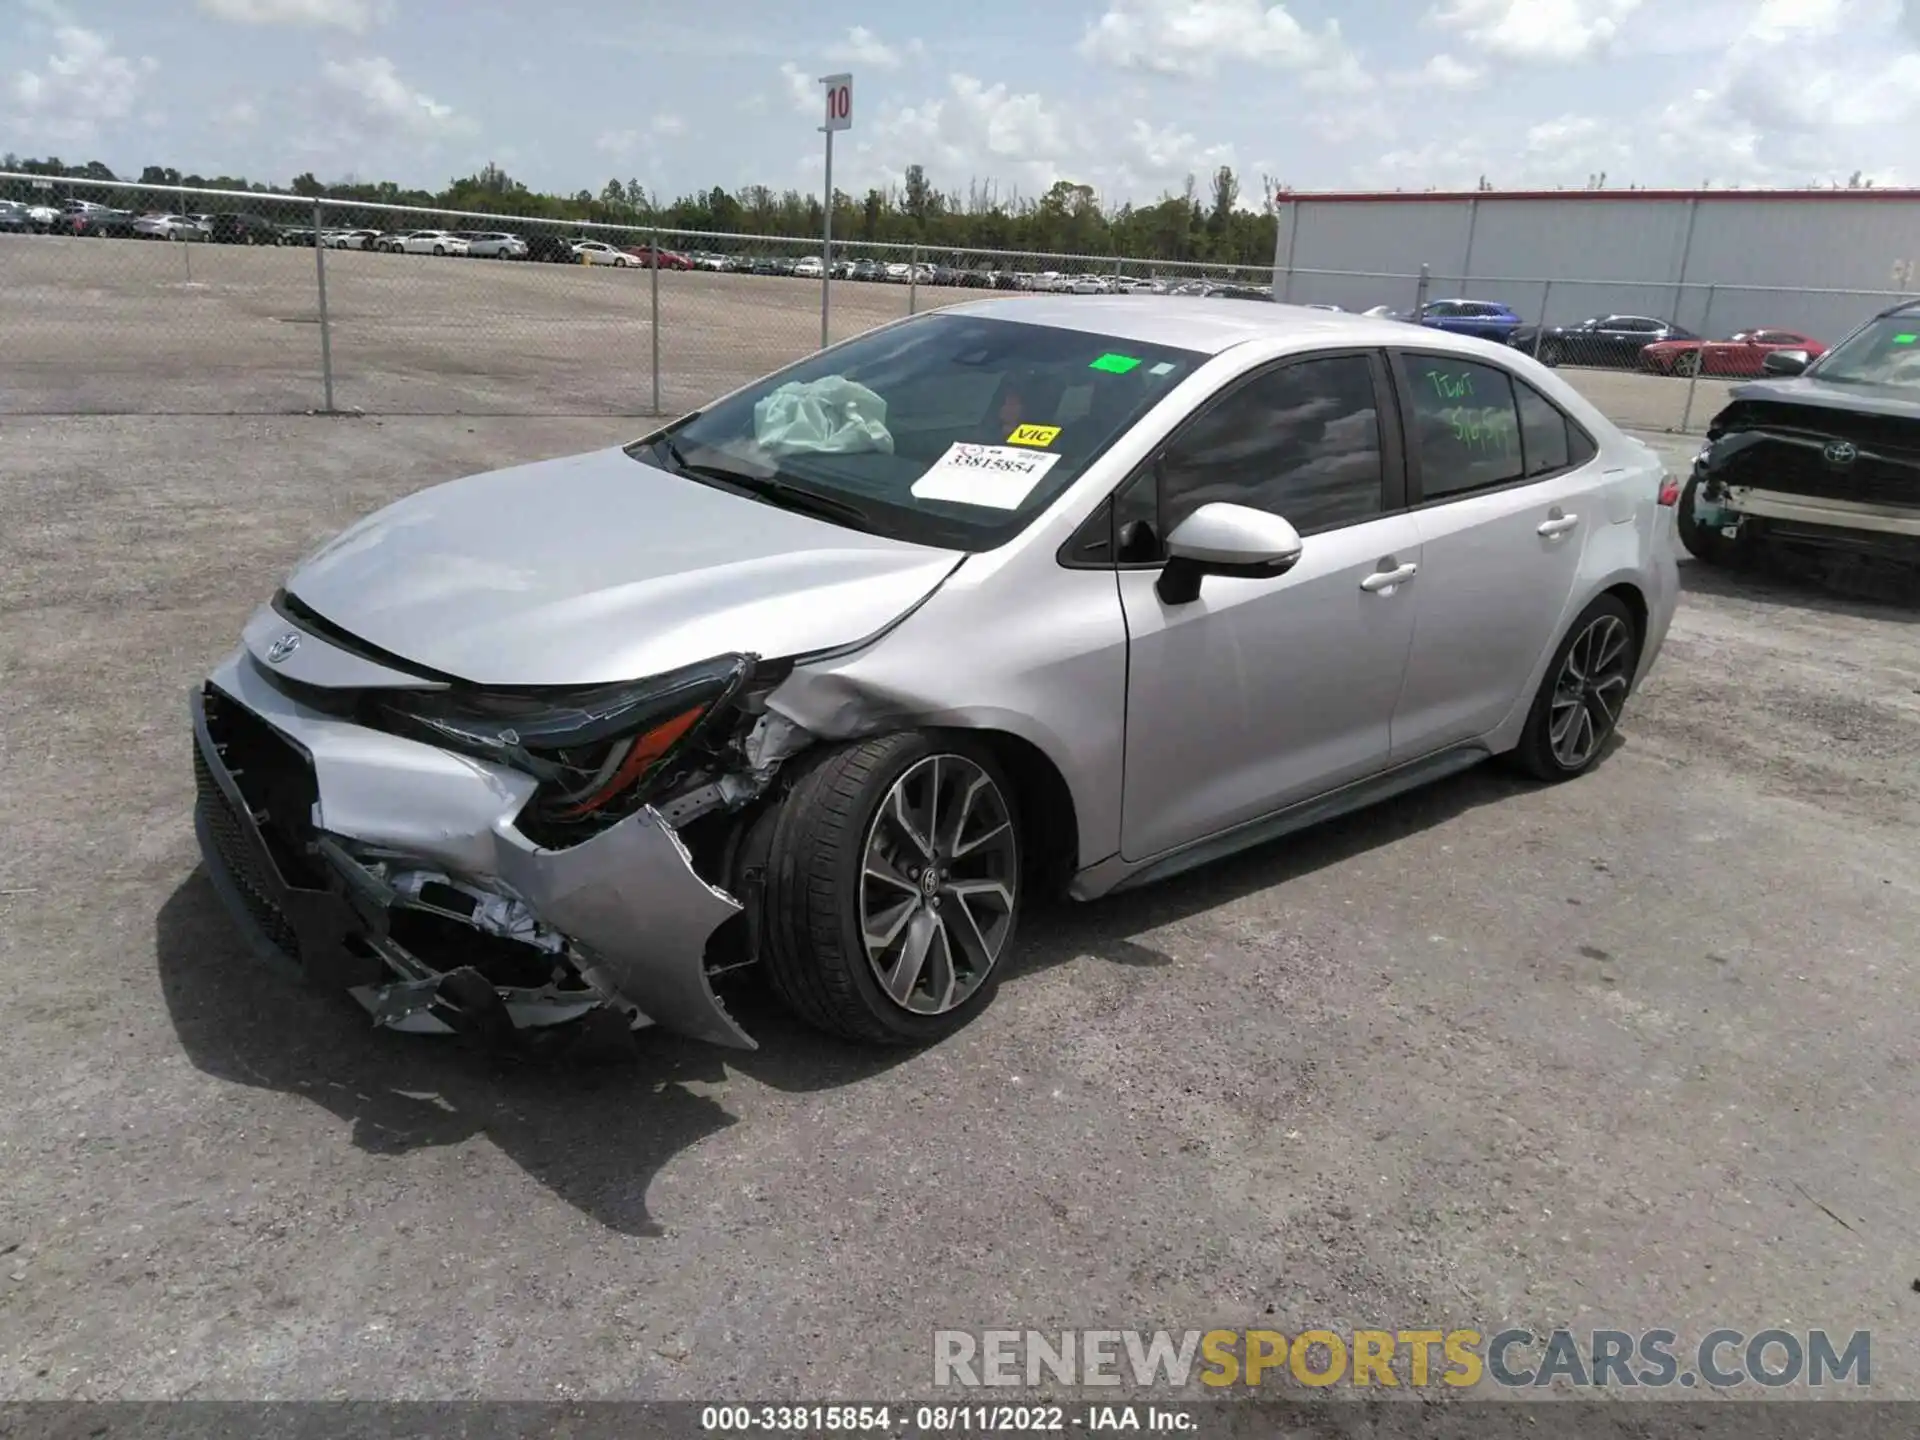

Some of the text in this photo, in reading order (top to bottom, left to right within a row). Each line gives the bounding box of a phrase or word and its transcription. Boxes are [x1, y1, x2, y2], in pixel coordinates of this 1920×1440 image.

[828, 86, 849, 119] 10
[1018, 429, 1053, 441] VIC
[948, 455, 1036, 474] 33815854
